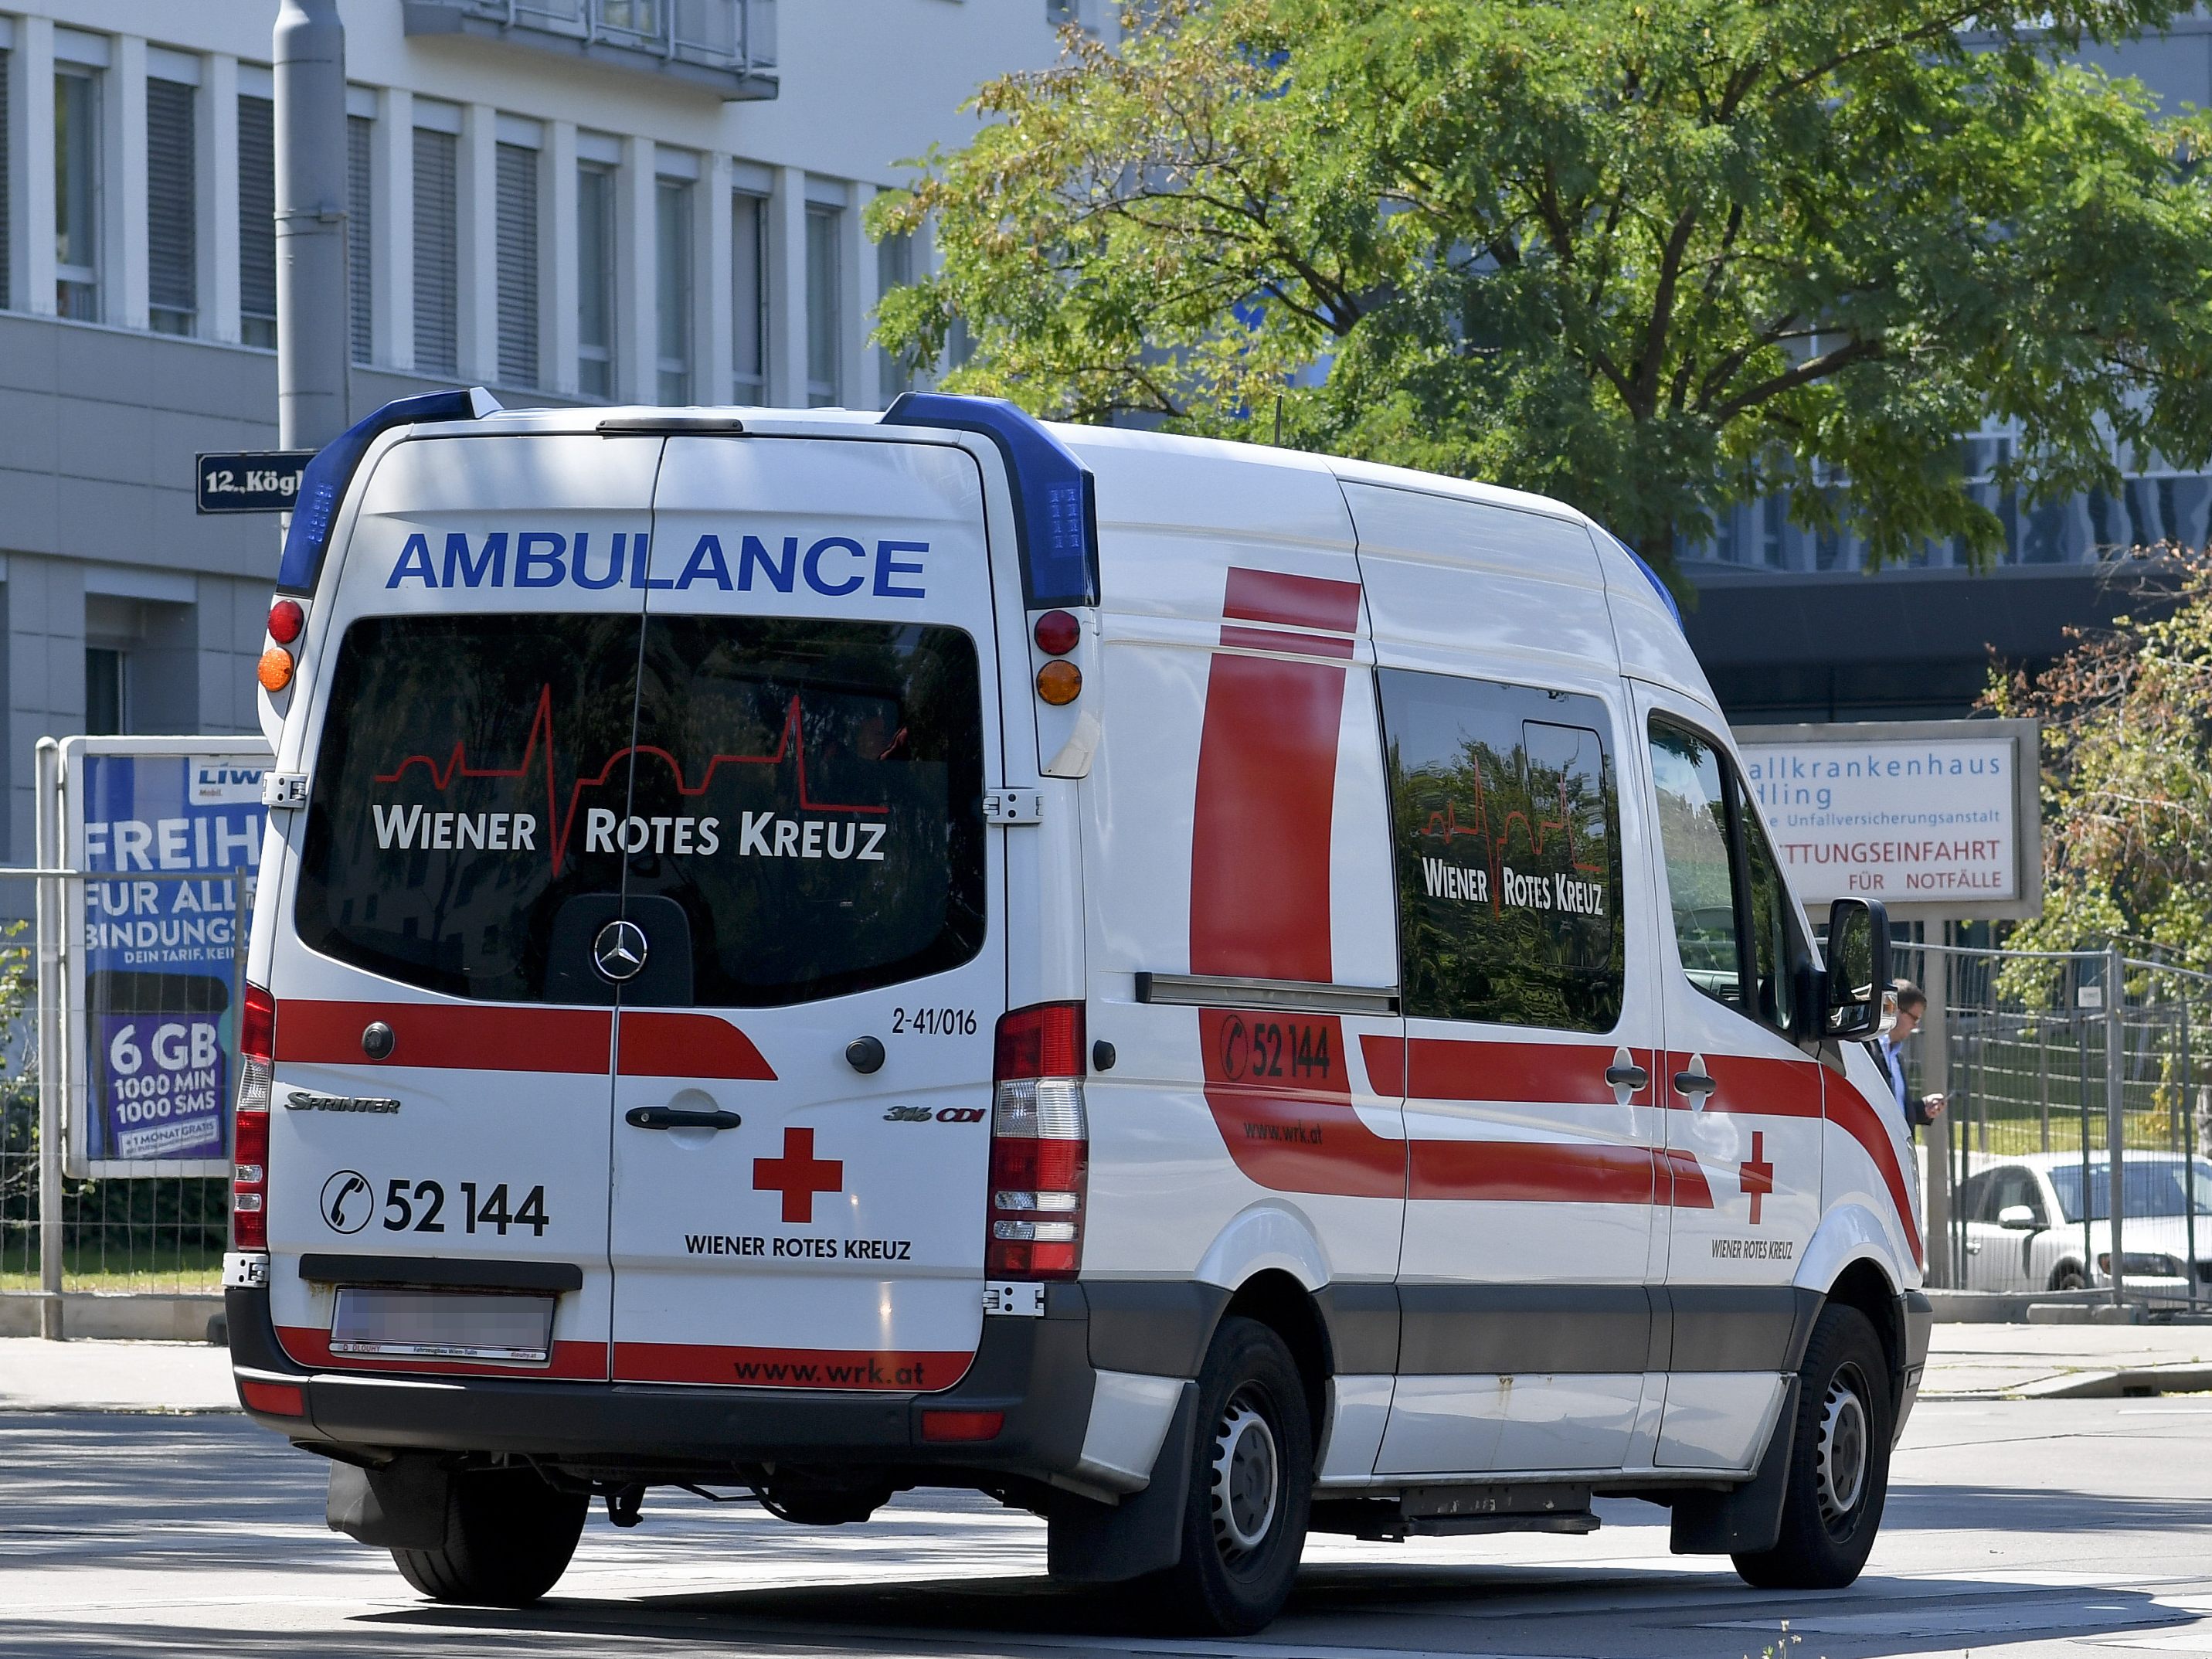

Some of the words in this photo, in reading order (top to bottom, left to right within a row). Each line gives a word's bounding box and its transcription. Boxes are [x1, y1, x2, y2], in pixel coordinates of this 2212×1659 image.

[385, 532, 929, 599] AMBULANCE
[1748, 753, 2000, 780] allkrankenhaus
[372, 804, 536, 852] WIENER
[586, 807, 719, 856] ROTES
[739, 811, 886, 861] KREUZ
[1787, 810, 2000, 828] Unfallversicherungsanstalt
[84, 814, 260, 872] FREIH
[1779, 840, 2000, 865] TTUNGSEINFAHRT
[1422, 857, 1488, 903] WIENER
[1504, 867, 1551, 909] ROTES
[1555, 872, 1603, 916] KREUZ
[1850, 870, 1884, 890] FÜR
[1906, 869, 2002, 889] NOTFÄLLE
[124, 951, 159, 964] DEIN
[163, 948, 204, 963] TARIF.
[892, 1007, 977, 1035] 2-41/016
[110, 1024, 142, 1075] 6
[151, 1022, 217, 1071] GB
[1252, 1024, 1282, 1077] 52
[1289, 1026, 1330, 1079] 144
[115, 1073, 171, 1101] 1000
[174, 1069, 216, 1093] MIN
[117, 1097, 172, 1124] 1000
[175, 1090, 216, 1115] SMS
[883, 1105, 933, 1122] 316
[936, 1107, 987, 1123] CDI
[141, 1129, 179, 1144] MONAT
[1243, 1119, 1323, 1144] www.wrk.at
[383, 1179, 445, 1233] 52
[460, 1182, 549, 1237] 144
[685, 1234, 766, 1256] WIENER
[773, 1238, 838, 1259] ROTES
[844, 1239, 912, 1261] KREUZ
[1711, 1239, 1741, 1259] WIENER
[1743, 1240, 1767, 1260] ROTES
[1769, 1241, 1793, 1260] KREUZ
[734, 1357, 924, 1385] www.wrk.at
